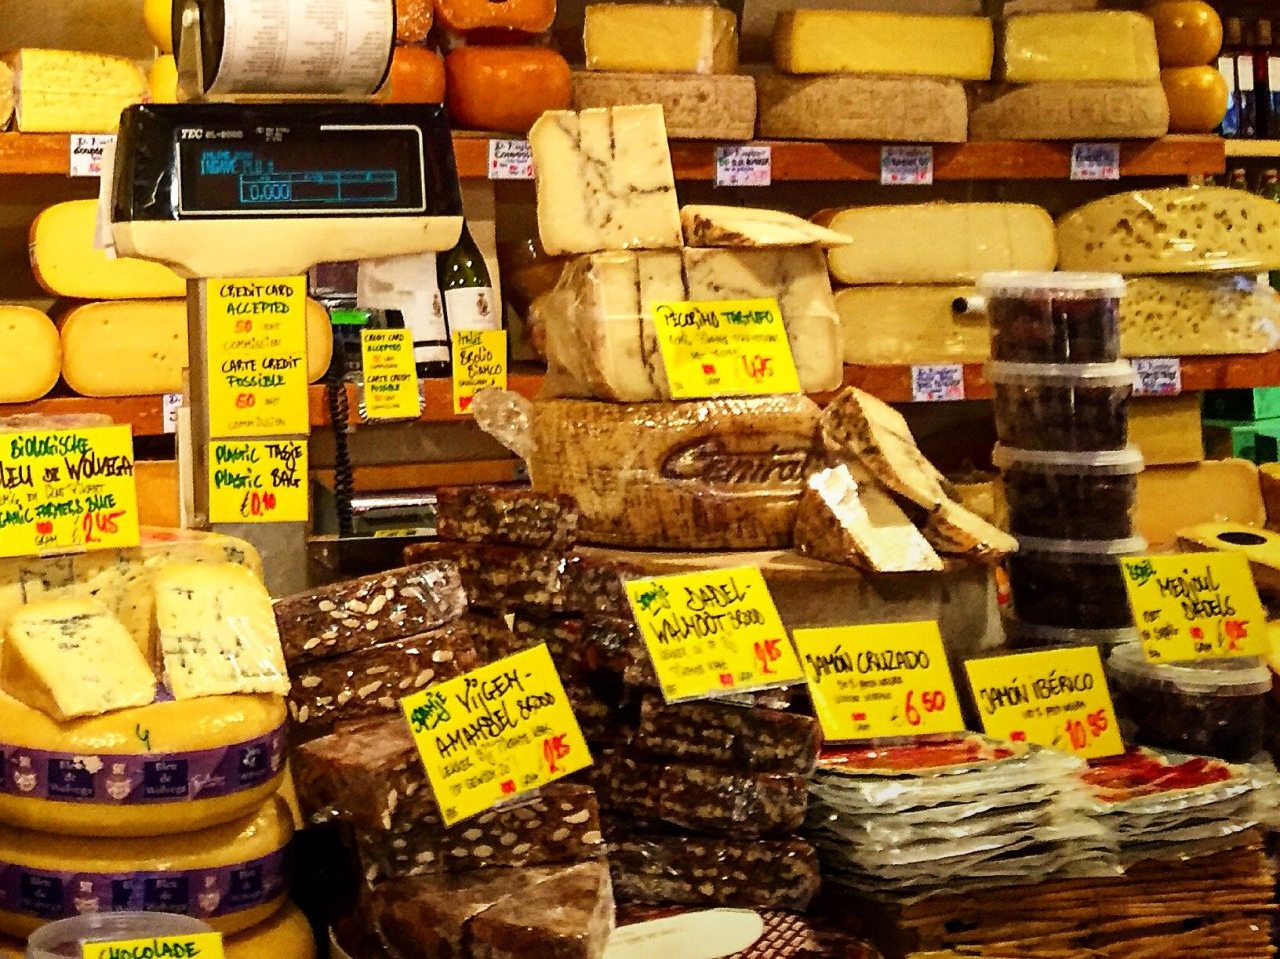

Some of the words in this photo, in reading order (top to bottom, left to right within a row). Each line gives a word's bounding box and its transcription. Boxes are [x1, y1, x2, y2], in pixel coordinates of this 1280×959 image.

[181, 128, 203, 139] TEC
[265, 285, 294, 298] CARD
[226, 301, 290, 315] ACCEPTED
[221, 359, 257, 373] CARTE
[64, 451, 134, 481] WOLVEGA
[271, 468, 301, 488] BAG
[86, 494, 117, 513] BLUE
[857, 650, 930, 674] CRUZADO
